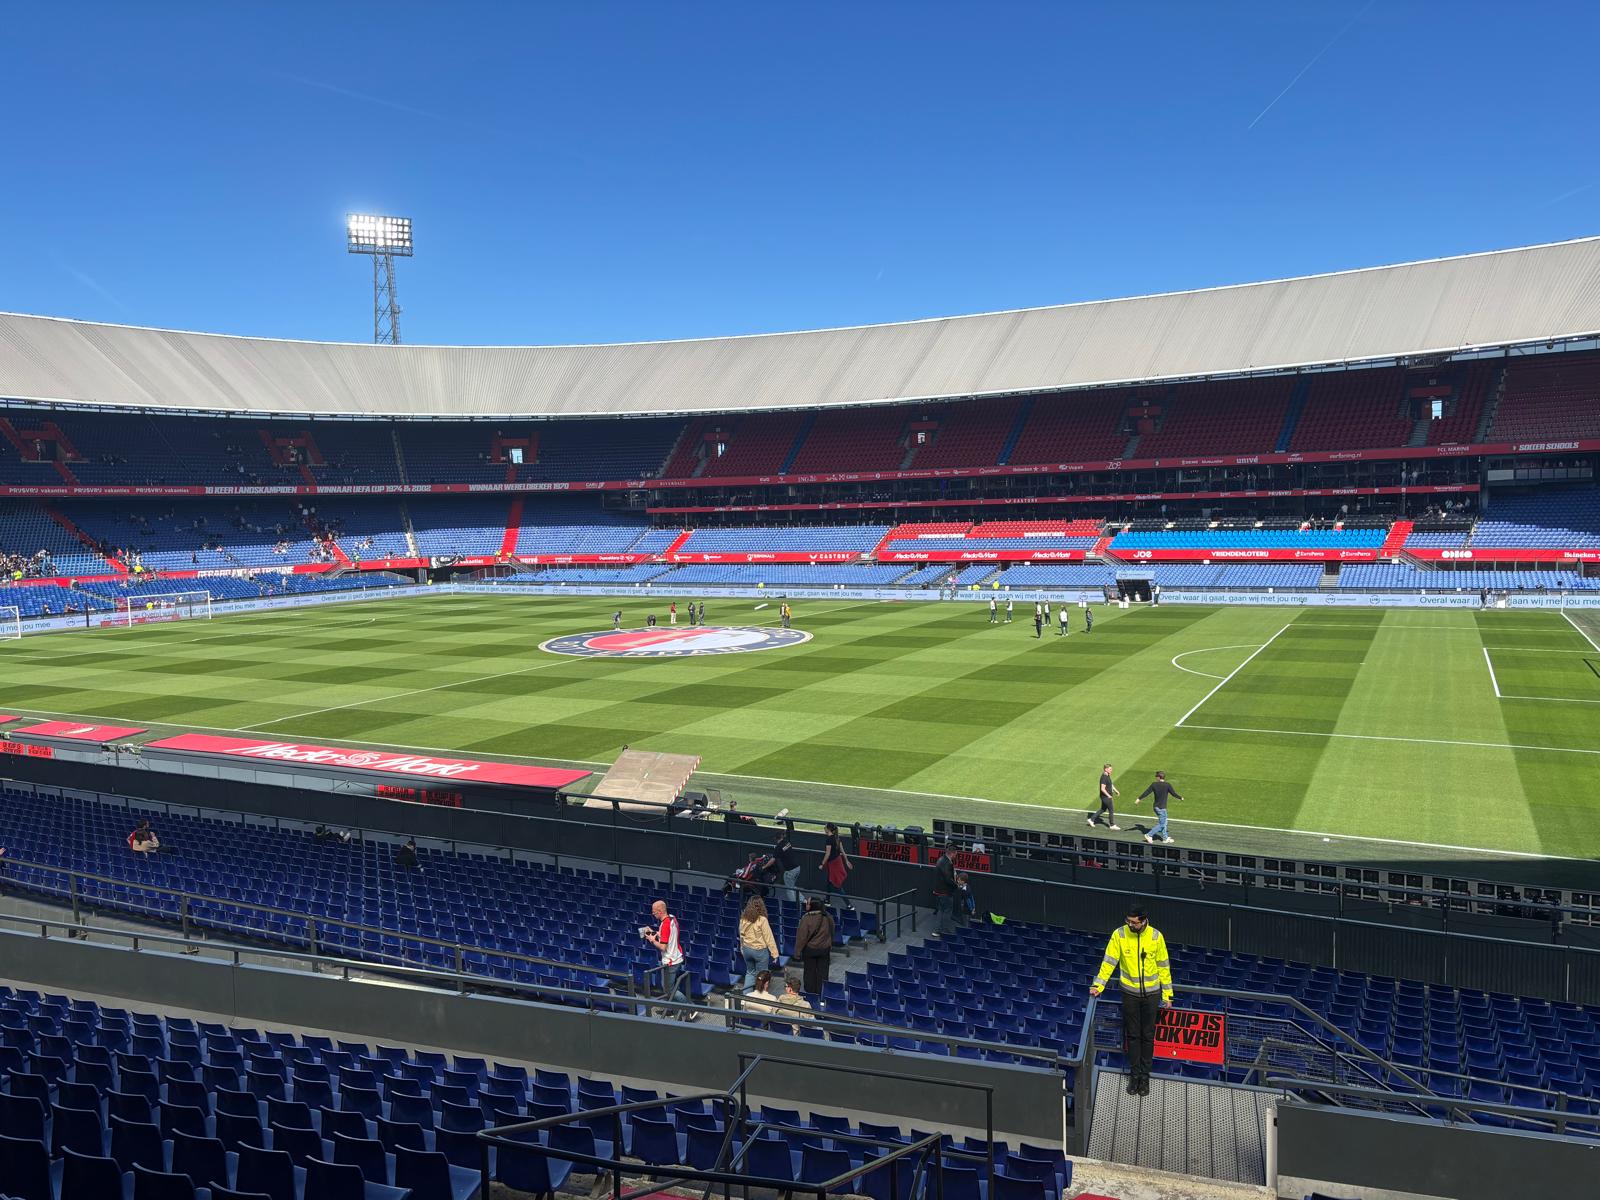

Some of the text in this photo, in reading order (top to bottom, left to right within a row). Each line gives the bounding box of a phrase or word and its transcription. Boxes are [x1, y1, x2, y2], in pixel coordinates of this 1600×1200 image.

[1531, 598, 1544, 606] wij
[1156, 1010, 1222, 1031] KUIP IS
[1156, 1026, 1220, 1048] OKVRIJ
